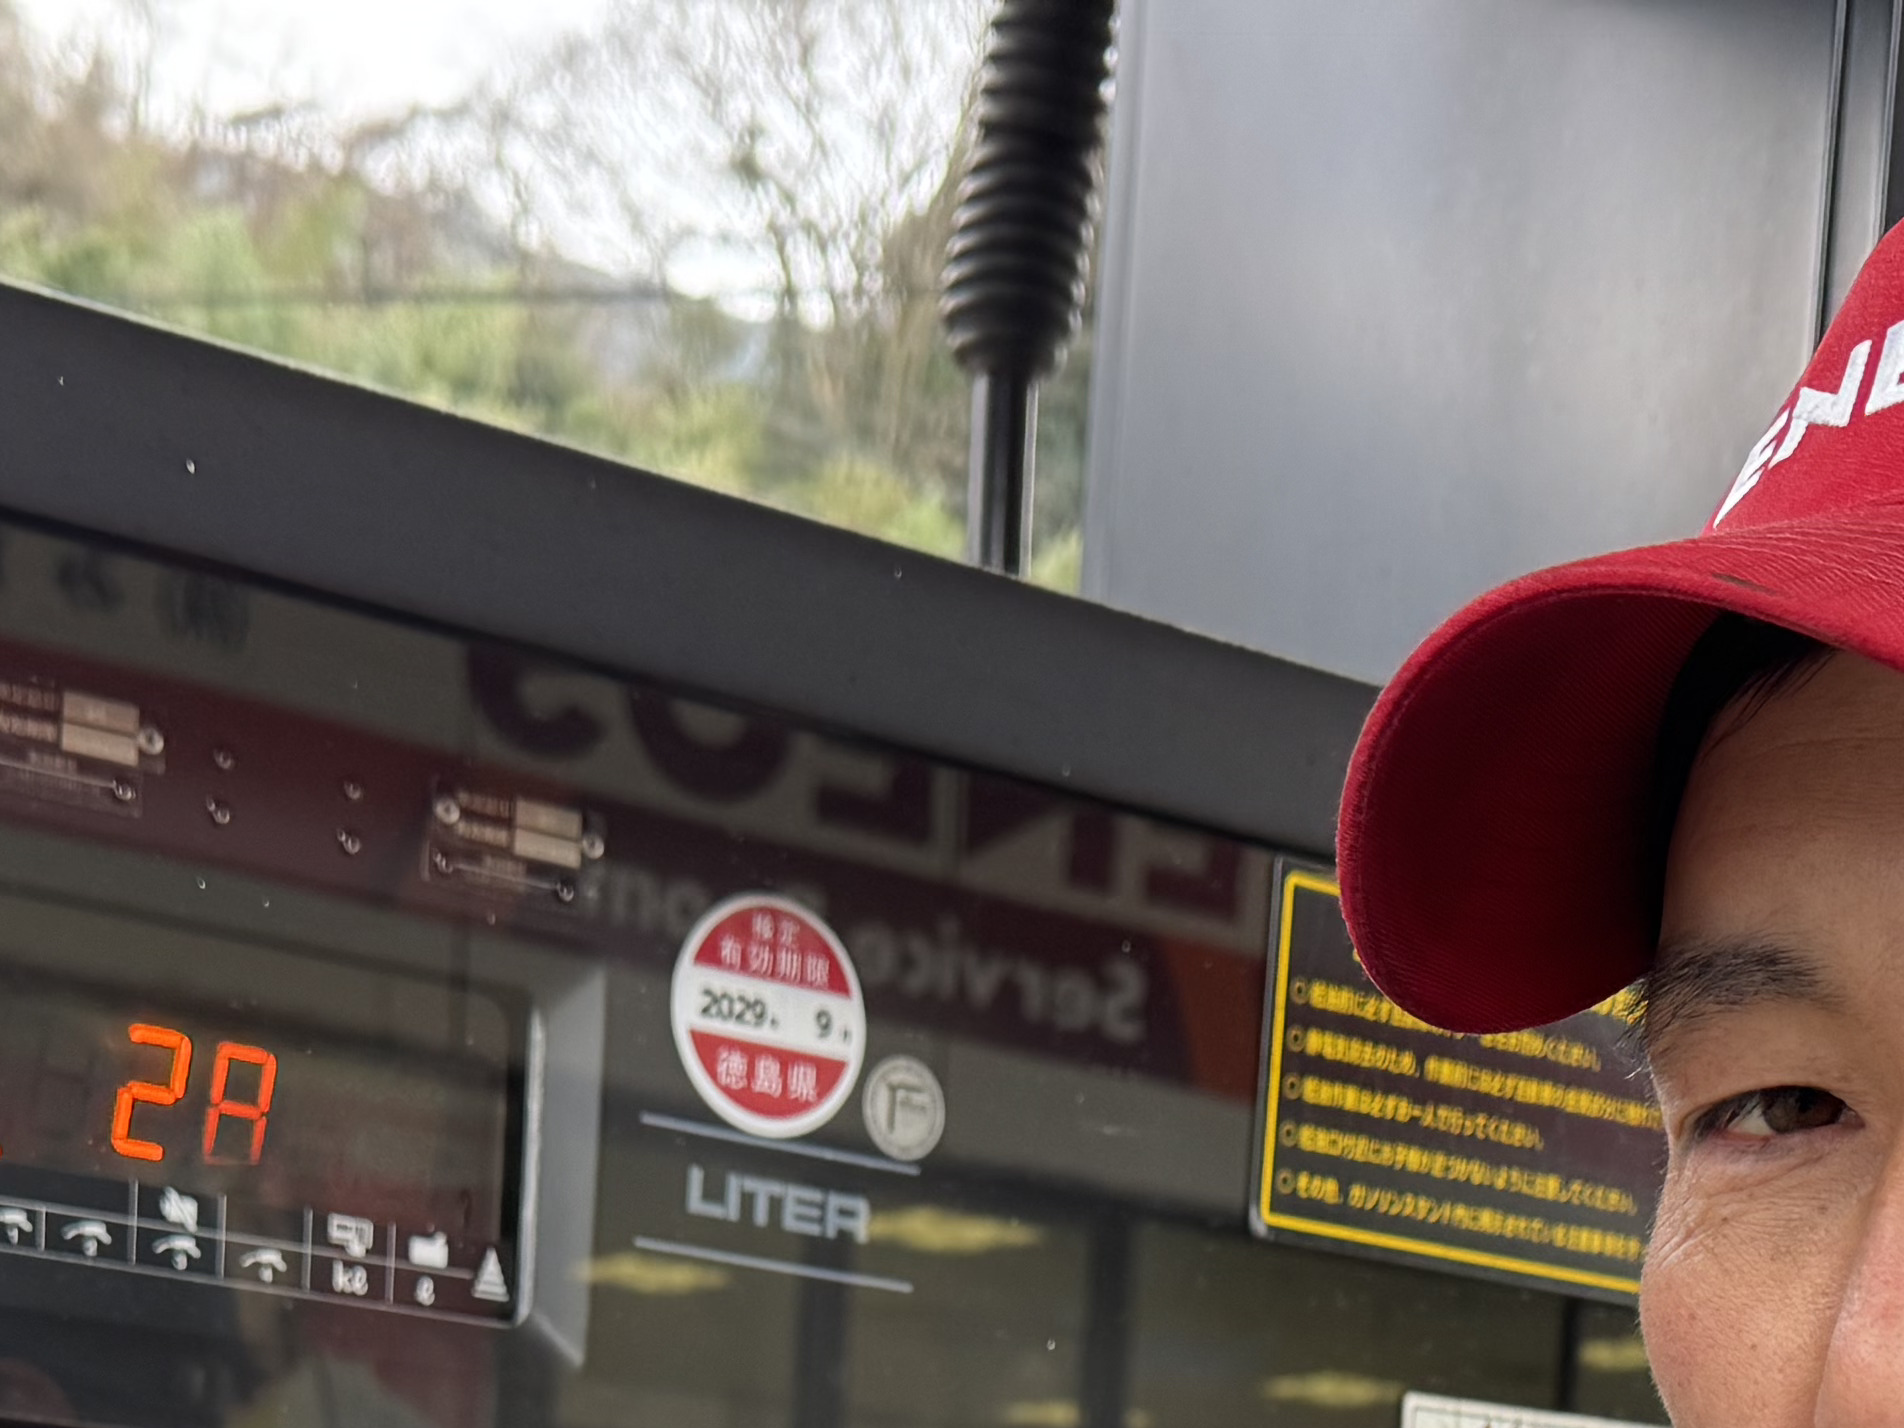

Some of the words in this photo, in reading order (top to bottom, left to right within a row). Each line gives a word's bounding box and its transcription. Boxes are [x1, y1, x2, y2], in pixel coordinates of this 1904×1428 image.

[716, 1043, 818, 1104] 徳島県
[685, 1164, 871, 1245] LITER
